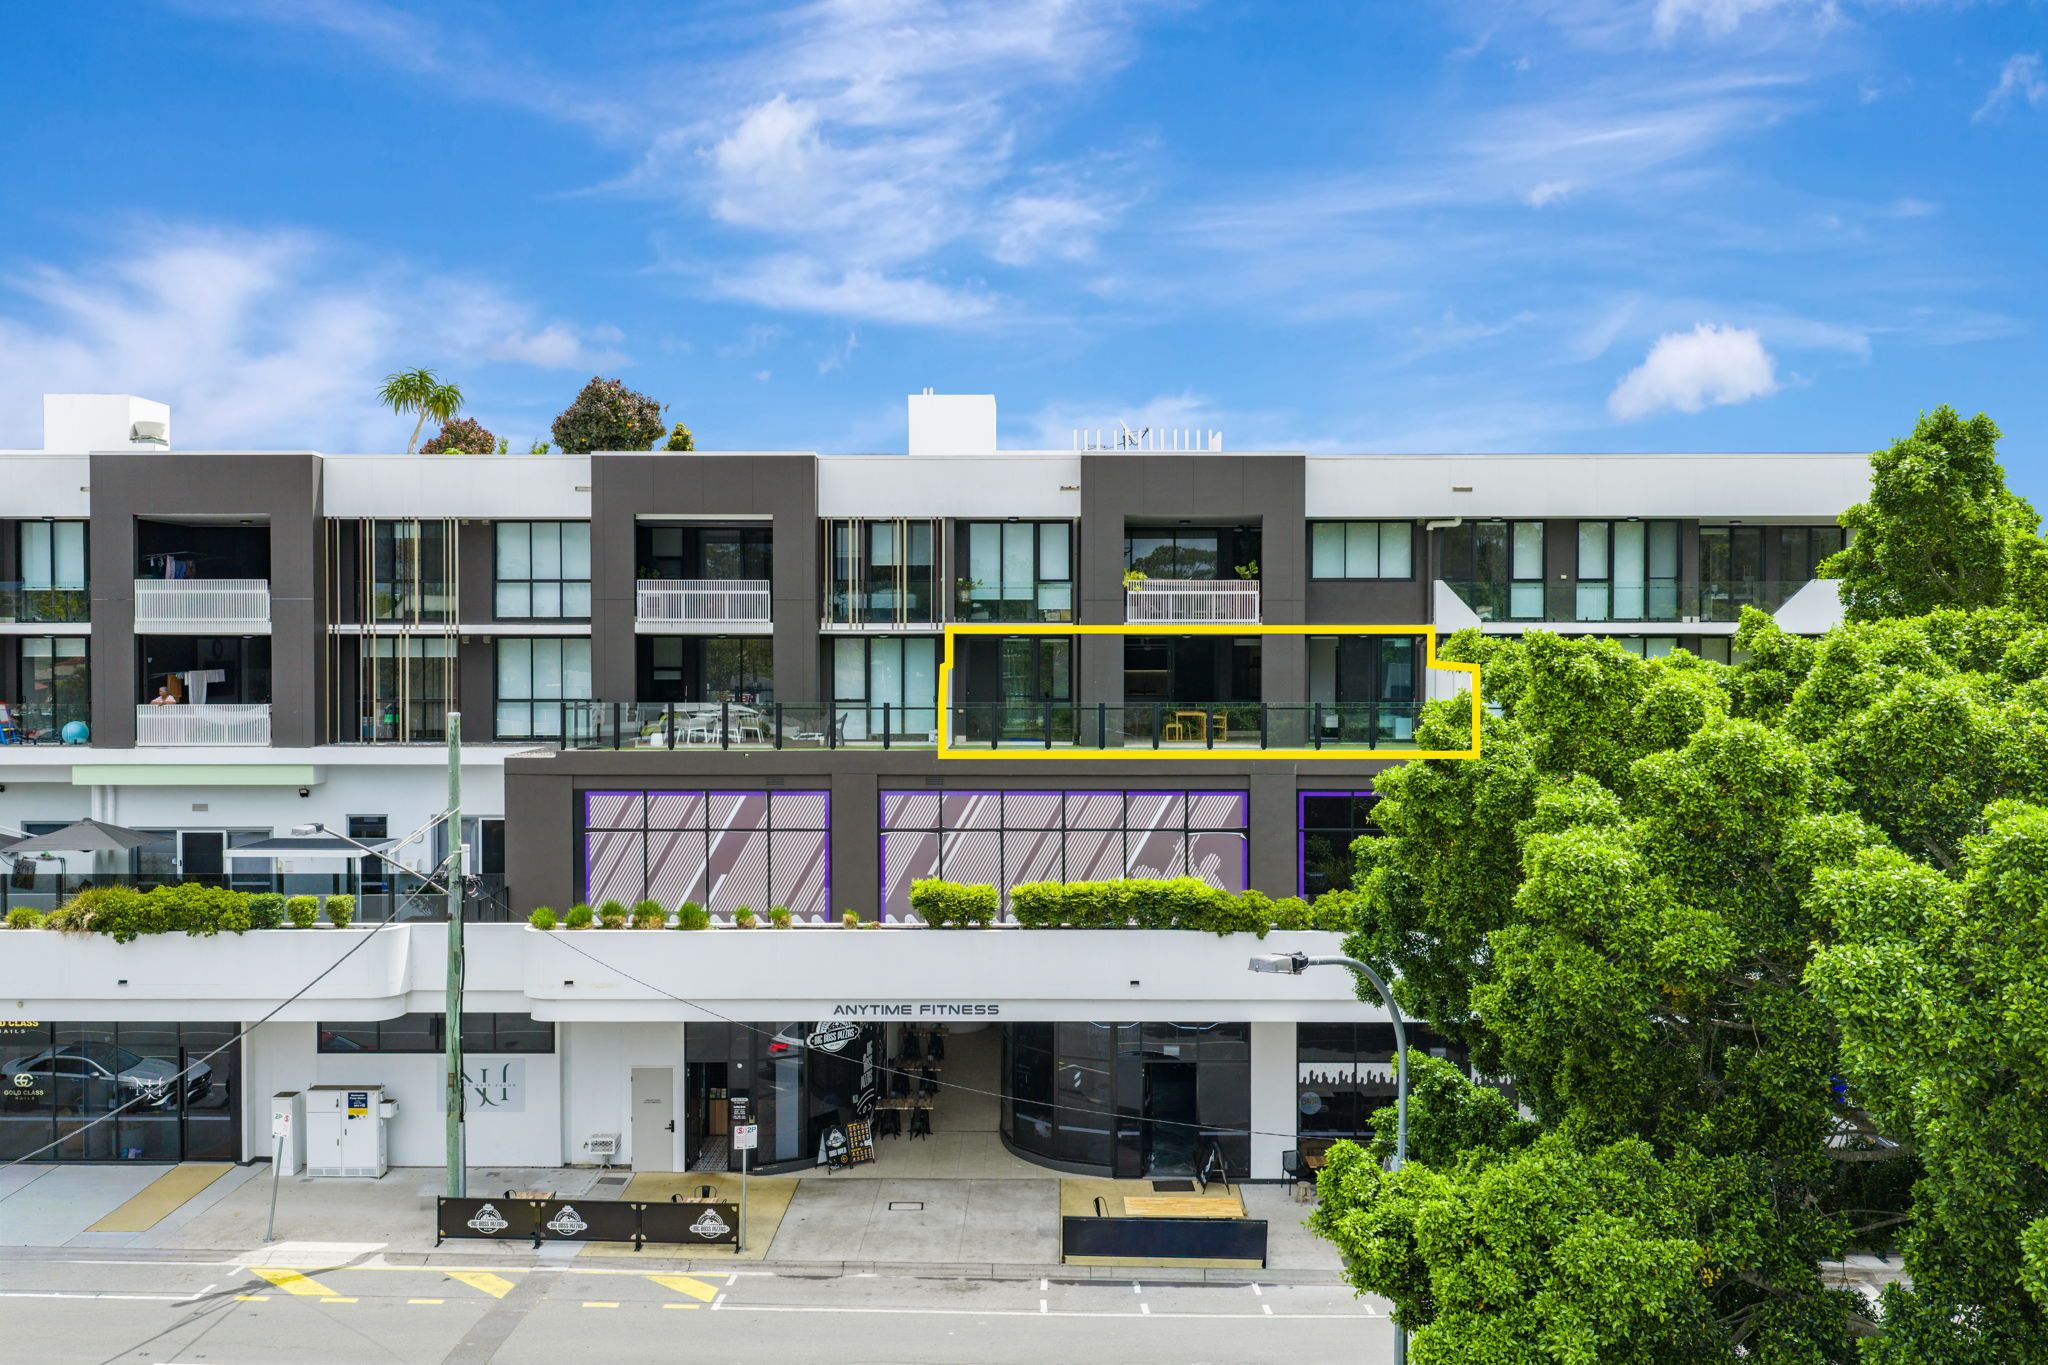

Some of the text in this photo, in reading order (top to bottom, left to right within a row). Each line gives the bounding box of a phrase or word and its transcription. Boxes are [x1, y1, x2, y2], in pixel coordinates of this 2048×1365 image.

[833, 1005, 999, 1015] ANYTIME FITNESS
[823, 1031, 837, 1043] BOSS
[837, 1028, 855, 1040] PIZZAS
[747, 1126, 757, 1134] 2P
